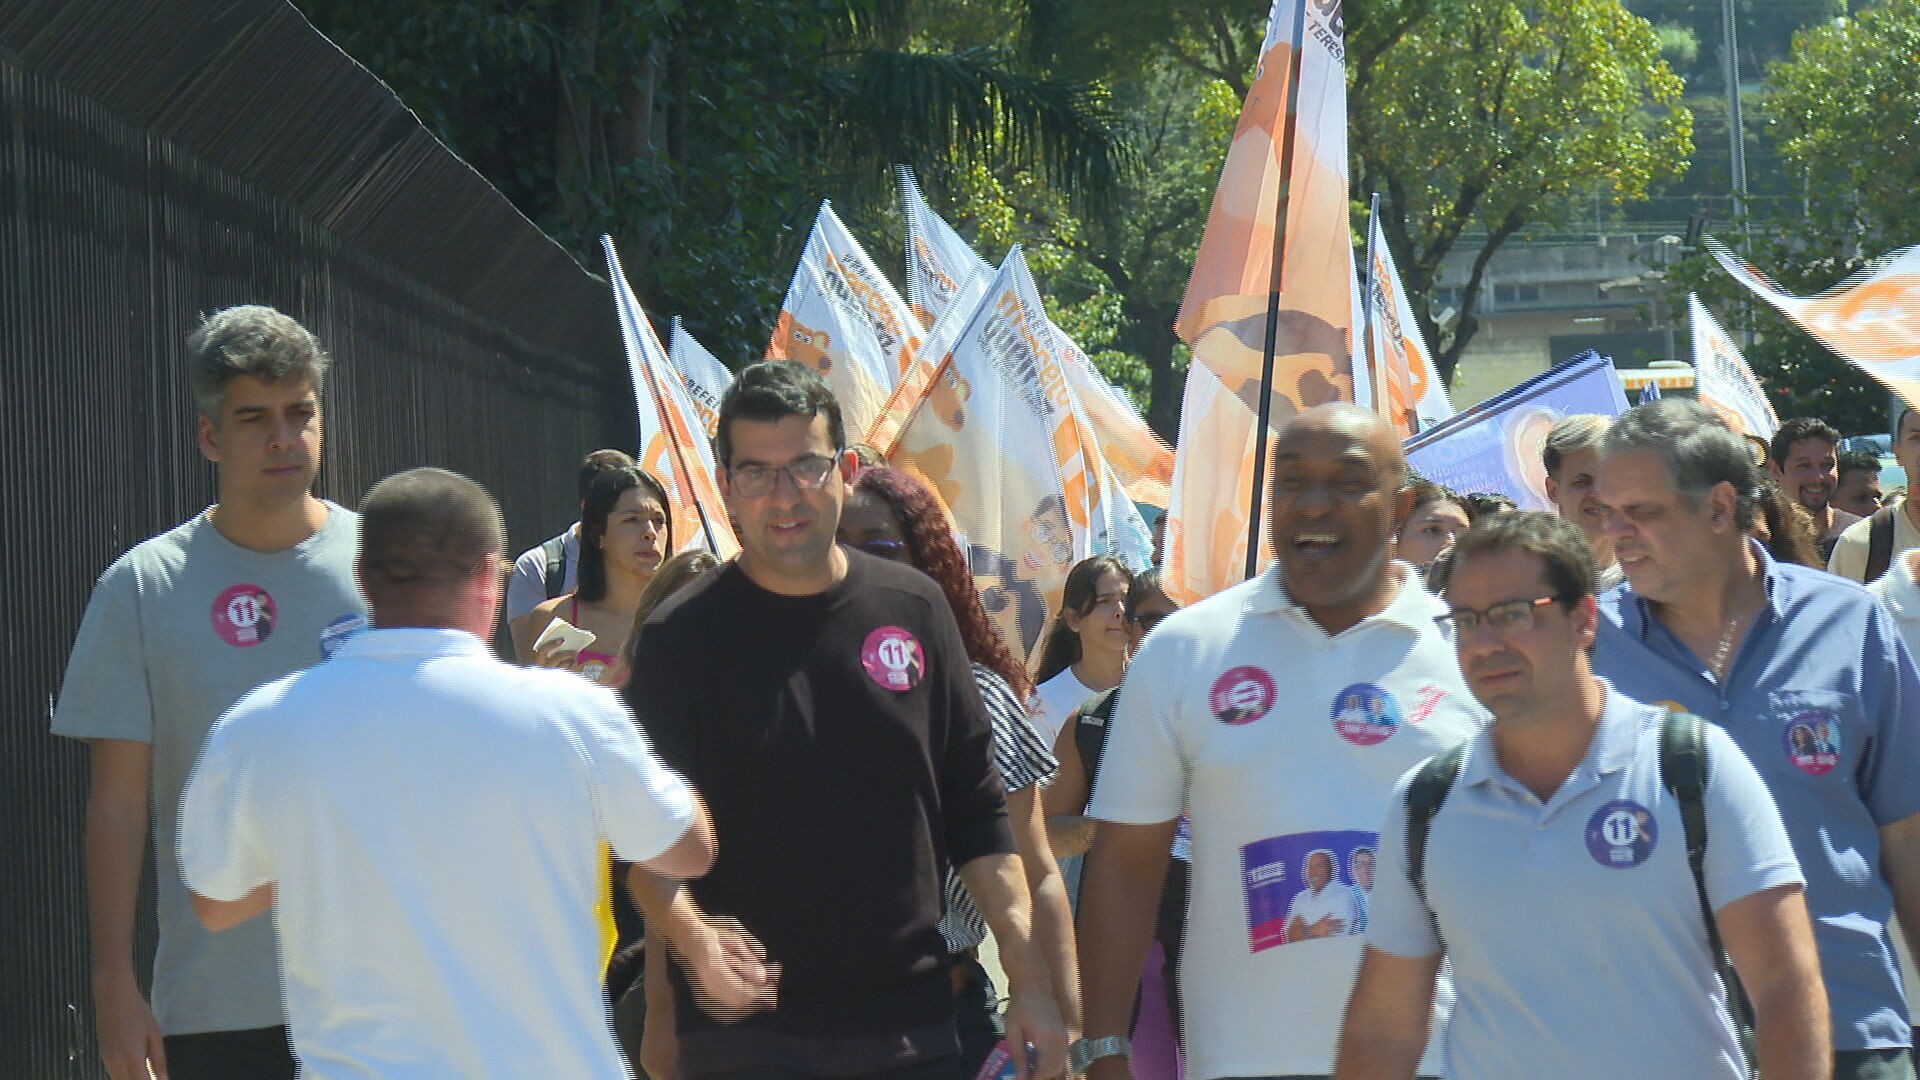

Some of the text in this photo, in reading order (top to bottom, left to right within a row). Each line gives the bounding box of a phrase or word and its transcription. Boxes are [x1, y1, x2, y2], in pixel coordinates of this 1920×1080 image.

[231, 601, 255, 623] 11
[882, 643, 904, 664] 11
[1607, 815, 1632, 840] 11
